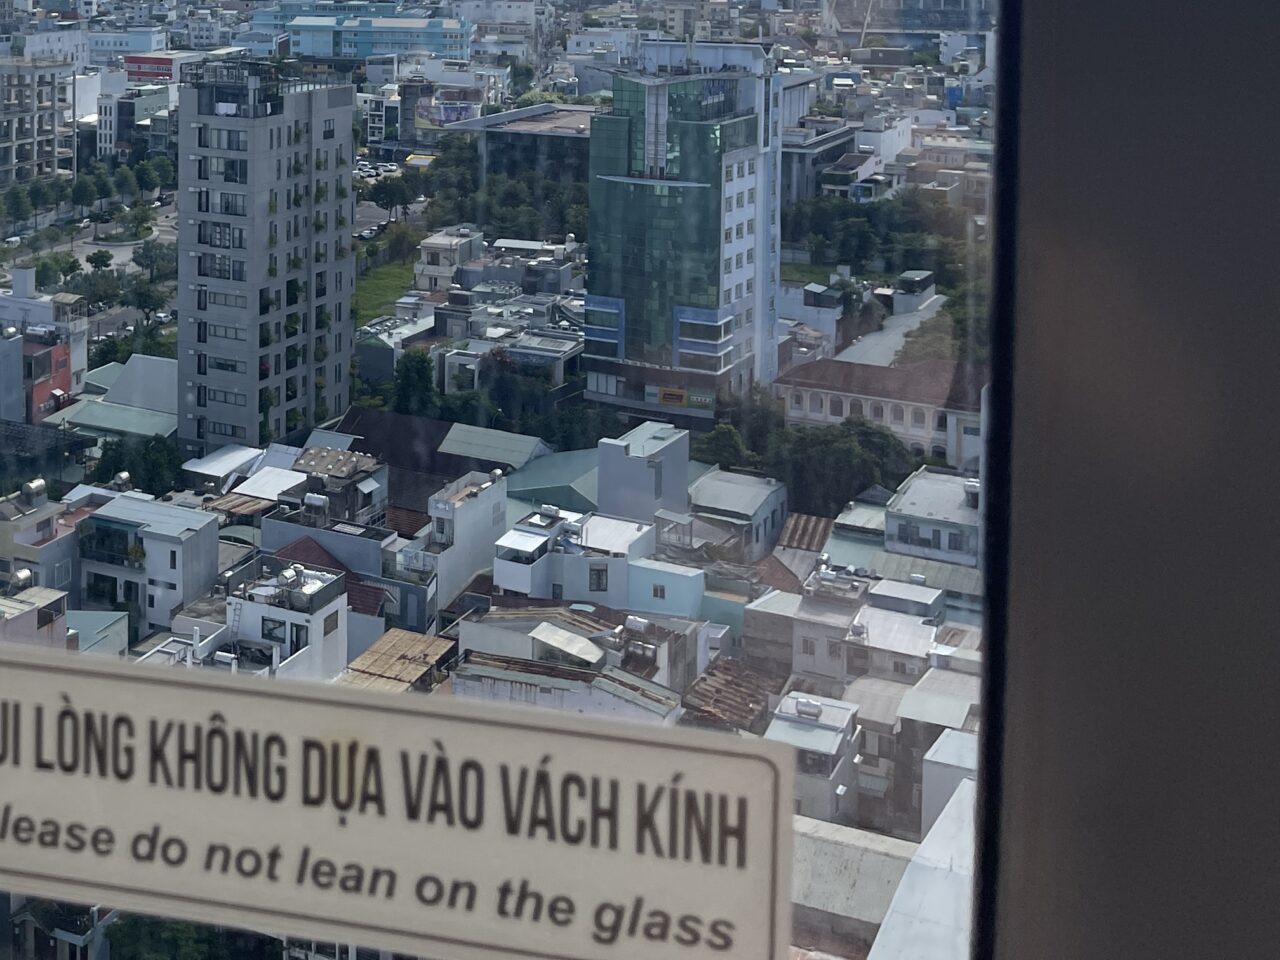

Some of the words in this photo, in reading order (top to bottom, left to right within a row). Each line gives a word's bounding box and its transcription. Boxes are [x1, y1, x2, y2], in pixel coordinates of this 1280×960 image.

[35, 691, 134, 781] LÒNG
[149, 712, 286, 803] KHÔNG
[302, 737, 385, 826] DỰA
[401, 740, 484, 830] VÀO
[500, 755, 618, 851] VÁCH
[636, 771, 748, 869] KÍNH
[131, 825, 187, 867] do
[205, 837, 281, 883] not
[297, 847, 396, 898] lean
[415, 872, 476, 912] on
[497, 877, 575, 927] the
[592, 897, 736, 951] glass
